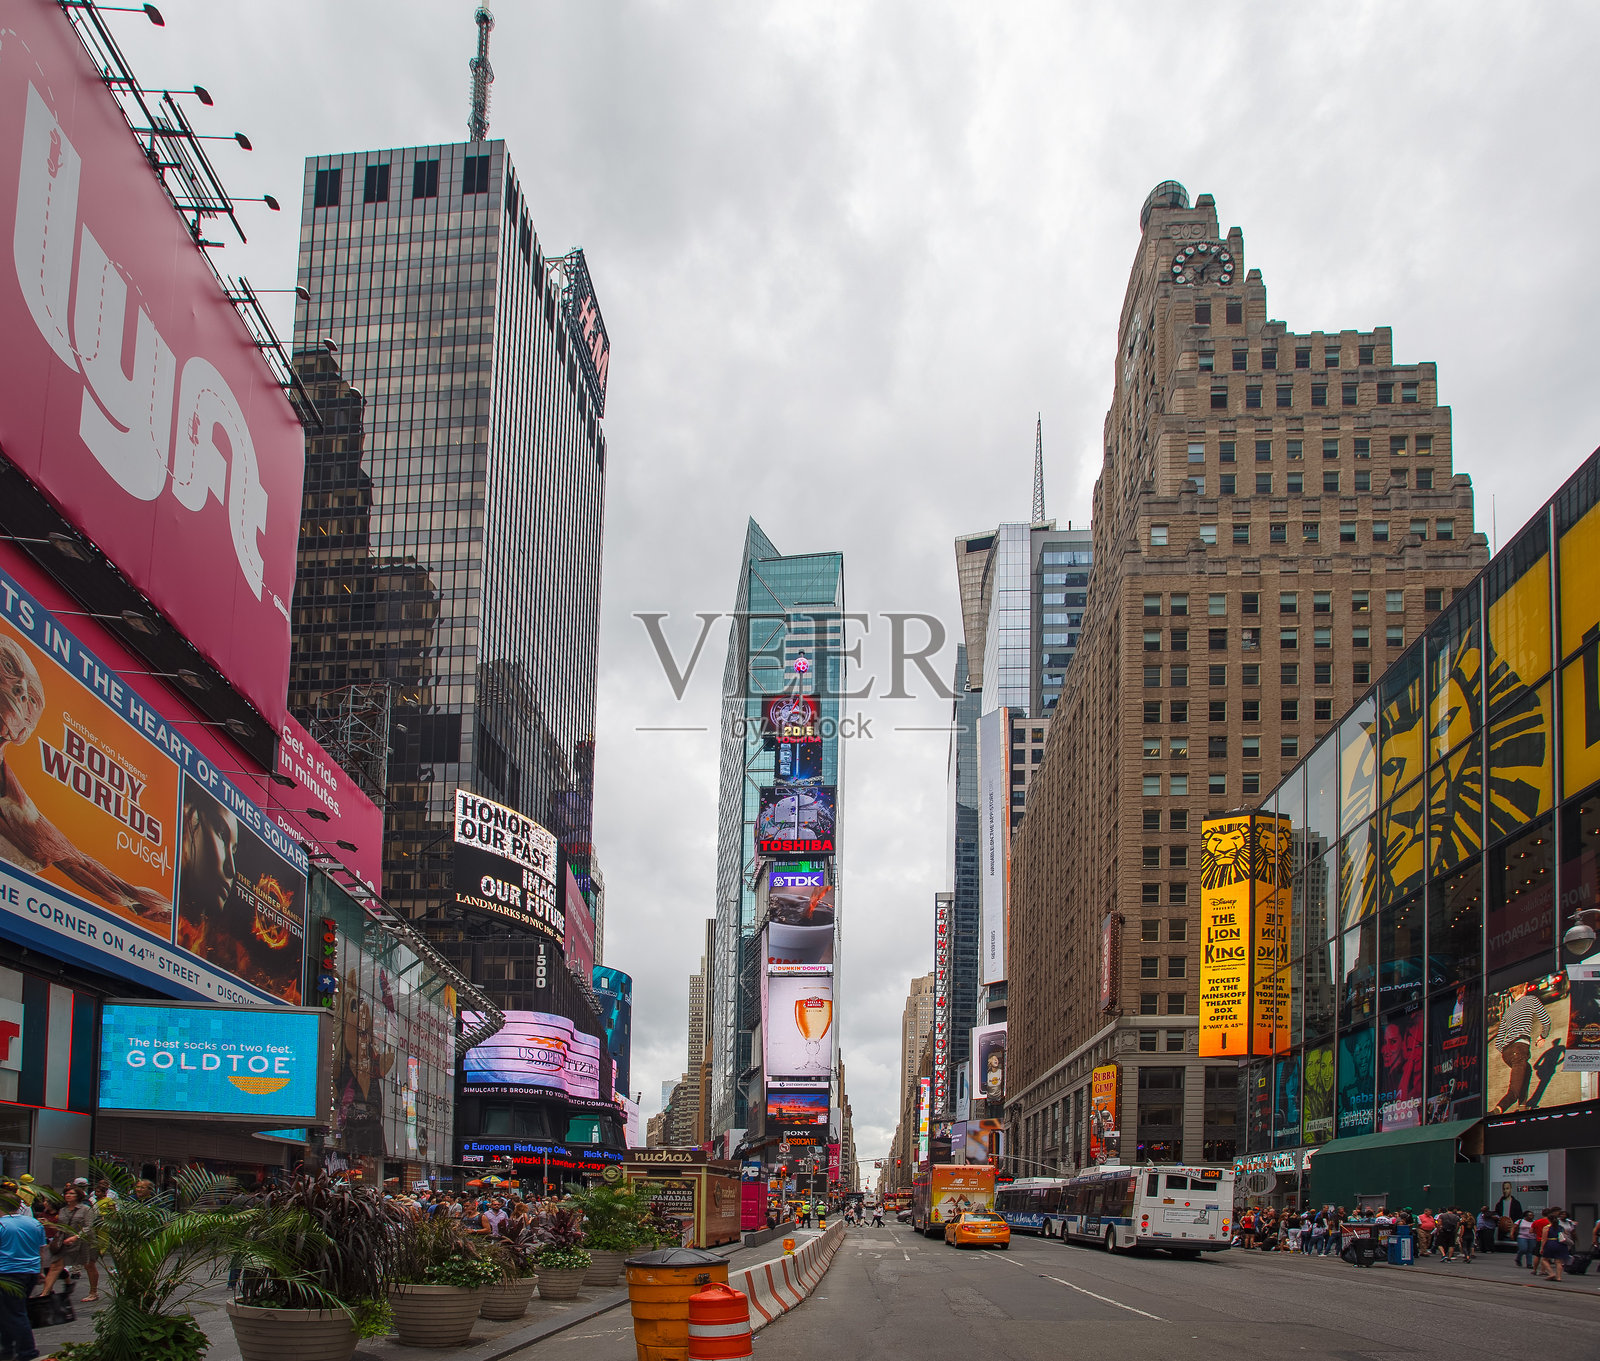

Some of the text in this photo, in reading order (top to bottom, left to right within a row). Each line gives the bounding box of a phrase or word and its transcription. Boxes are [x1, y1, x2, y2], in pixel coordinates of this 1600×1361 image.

[44, 624, 72, 663] IN
[78, 650, 124, 710] THE
[128, 696, 193, 766] HEART
[197, 760, 219, 788] OF
[221, 779, 261, 831] TIMES
[263, 821, 309, 872] SQUARE
[62, 722, 148, 805] BODY
[282, 725, 338, 792] Get a ride
[280, 745, 342, 818] in minutes.
[37, 736, 163, 847] WORLDS
[458, 795, 531, 843] HONOR
[460, 819, 549, 873] OUR PAST
[760, 840, 833, 851] TOSHIBA
[784, 876, 820, 886] TDK
[456, 892, 521, 919] LANDMARKS
[530, 916, 544, 931] NYC
[480, 875, 522, 908] OUR
[526, 890, 565, 934] FUTURE
[1208, 898, 1238, 906] Disney
[236, 885, 303, 940] THE EXHIBITION
[1212, 913, 1236, 924] THE
[27, 897, 98, 940] CORNER
[103, 931, 124, 952] ON
[128, 943, 155, 961] 44TH
[158, 956, 201, 985] STREET
[1208, 926, 1240, 944] LION
[936, 909, 948, 981] ERNST
[1205, 944, 1245, 964] KING
[536, 944, 546, 988] 1500
[1201, 991, 1246, 1000] MINSKOFF
[1206, 999, 1242, 1007] THEATRE
[128, 1037, 294, 1054] The best socks on two feet.
[518, 1047, 534, 1060] US
[934, 1022, 946, 1098] YOUNG
[1094, 1070, 1116, 1082] BUBBA
[1095, 1082, 1114, 1094] GUMP
[1449, 1078, 1456, 1095] 9
[1457, 1081, 1468, 1090] PM
[472, 1143, 511, 1152] European
[584, 1150, 602, 1158] Rick
[634, 1150, 693, 1162] nuchas
[1502, 1165, 1536, 1174] TISSOT
